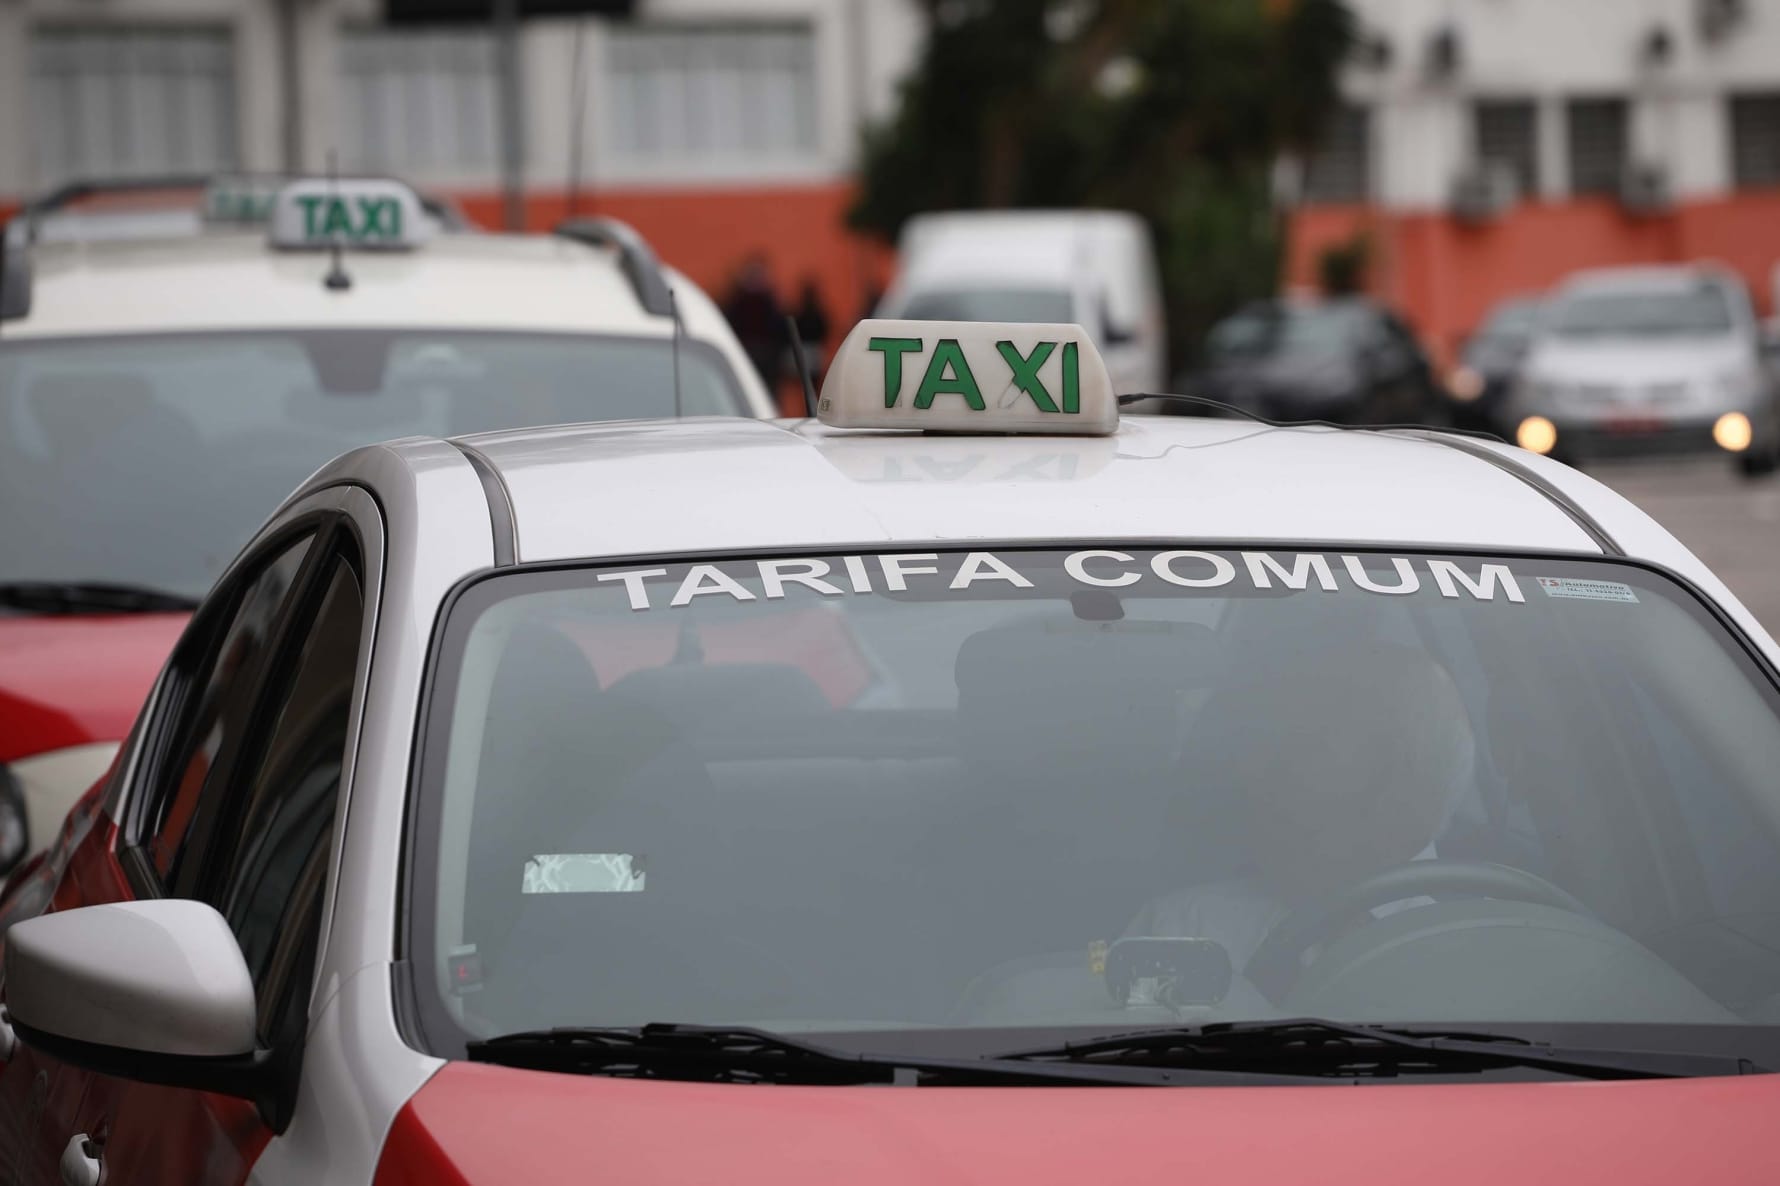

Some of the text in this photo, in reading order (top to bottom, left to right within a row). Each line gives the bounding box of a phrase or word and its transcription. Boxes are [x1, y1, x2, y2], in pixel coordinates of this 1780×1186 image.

[293, 194, 404, 239] TAXI
[868, 337, 1081, 414] TAXI
[596, 549, 1526, 610] TARIFA COMUM
